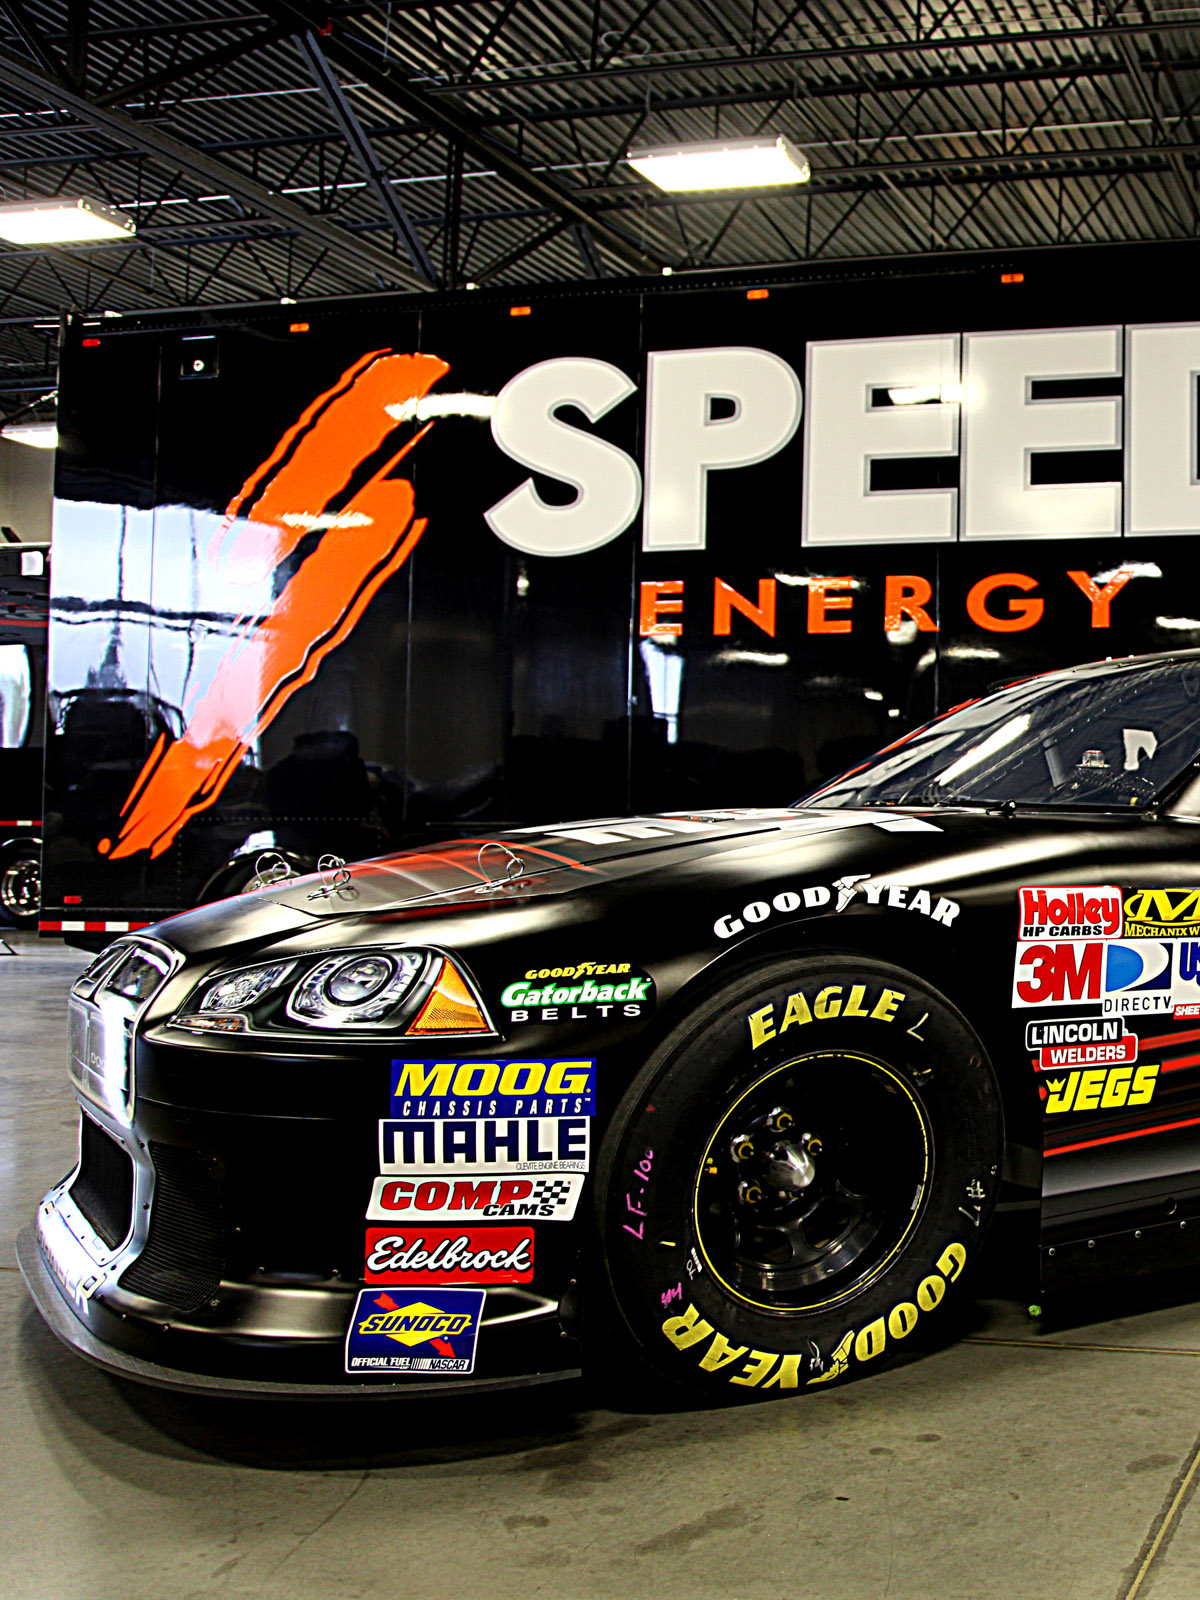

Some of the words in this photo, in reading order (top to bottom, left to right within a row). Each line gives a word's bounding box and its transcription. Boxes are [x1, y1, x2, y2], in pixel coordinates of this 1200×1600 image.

[639, 570, 1133, 637] ENERGY
[713, 874, 961, 940] GOODYEAR
[1023, 889, 1120, 935] Holley
[1023, 926, 1046, 937] HP
[1049, 925, 1103, 937] CARBS
[1124, 921, 1188, 937] MECHANIX
[524, 962, 632, 980] GOODYEAR
[1016, 943, 1104, 1003] 3M
[501, 977, 653, 1008] Gatorback
[1104, 995, 1173, 1013] DIRECTV
[511, 1004, 641, 1023] BELTS
[747, 985, 906, 1050] EAGLE
[1030, 1021, 1119, 1046] LINCOLN
[1049, 1044, 1127, 1064] WELDERS
[394, 1061, 592, 1097] MOOG
[1045, 1065, 1161, 1114] JEGS
[403, 1100, 496, 1117] CHASSIS
[515, 1097, 583, 1115] PARTS
[383, 1119, 586, 1164] MAHLE
[380, 1180, 534, 1211] COMP
[482, 1203, 554, 1217] CAMS
[366, 1236, 531, 1271] Edelbrock
[364, 1315, 467, 1332] SUNOCO
[661, 1242, 967, 1389] GOODYEAR
[351, 1357, 388, 1367] OFFICIAL
[389, 1357, 410, 1366] FUEL
[429, 1359, 466, 1370] NASCAR
